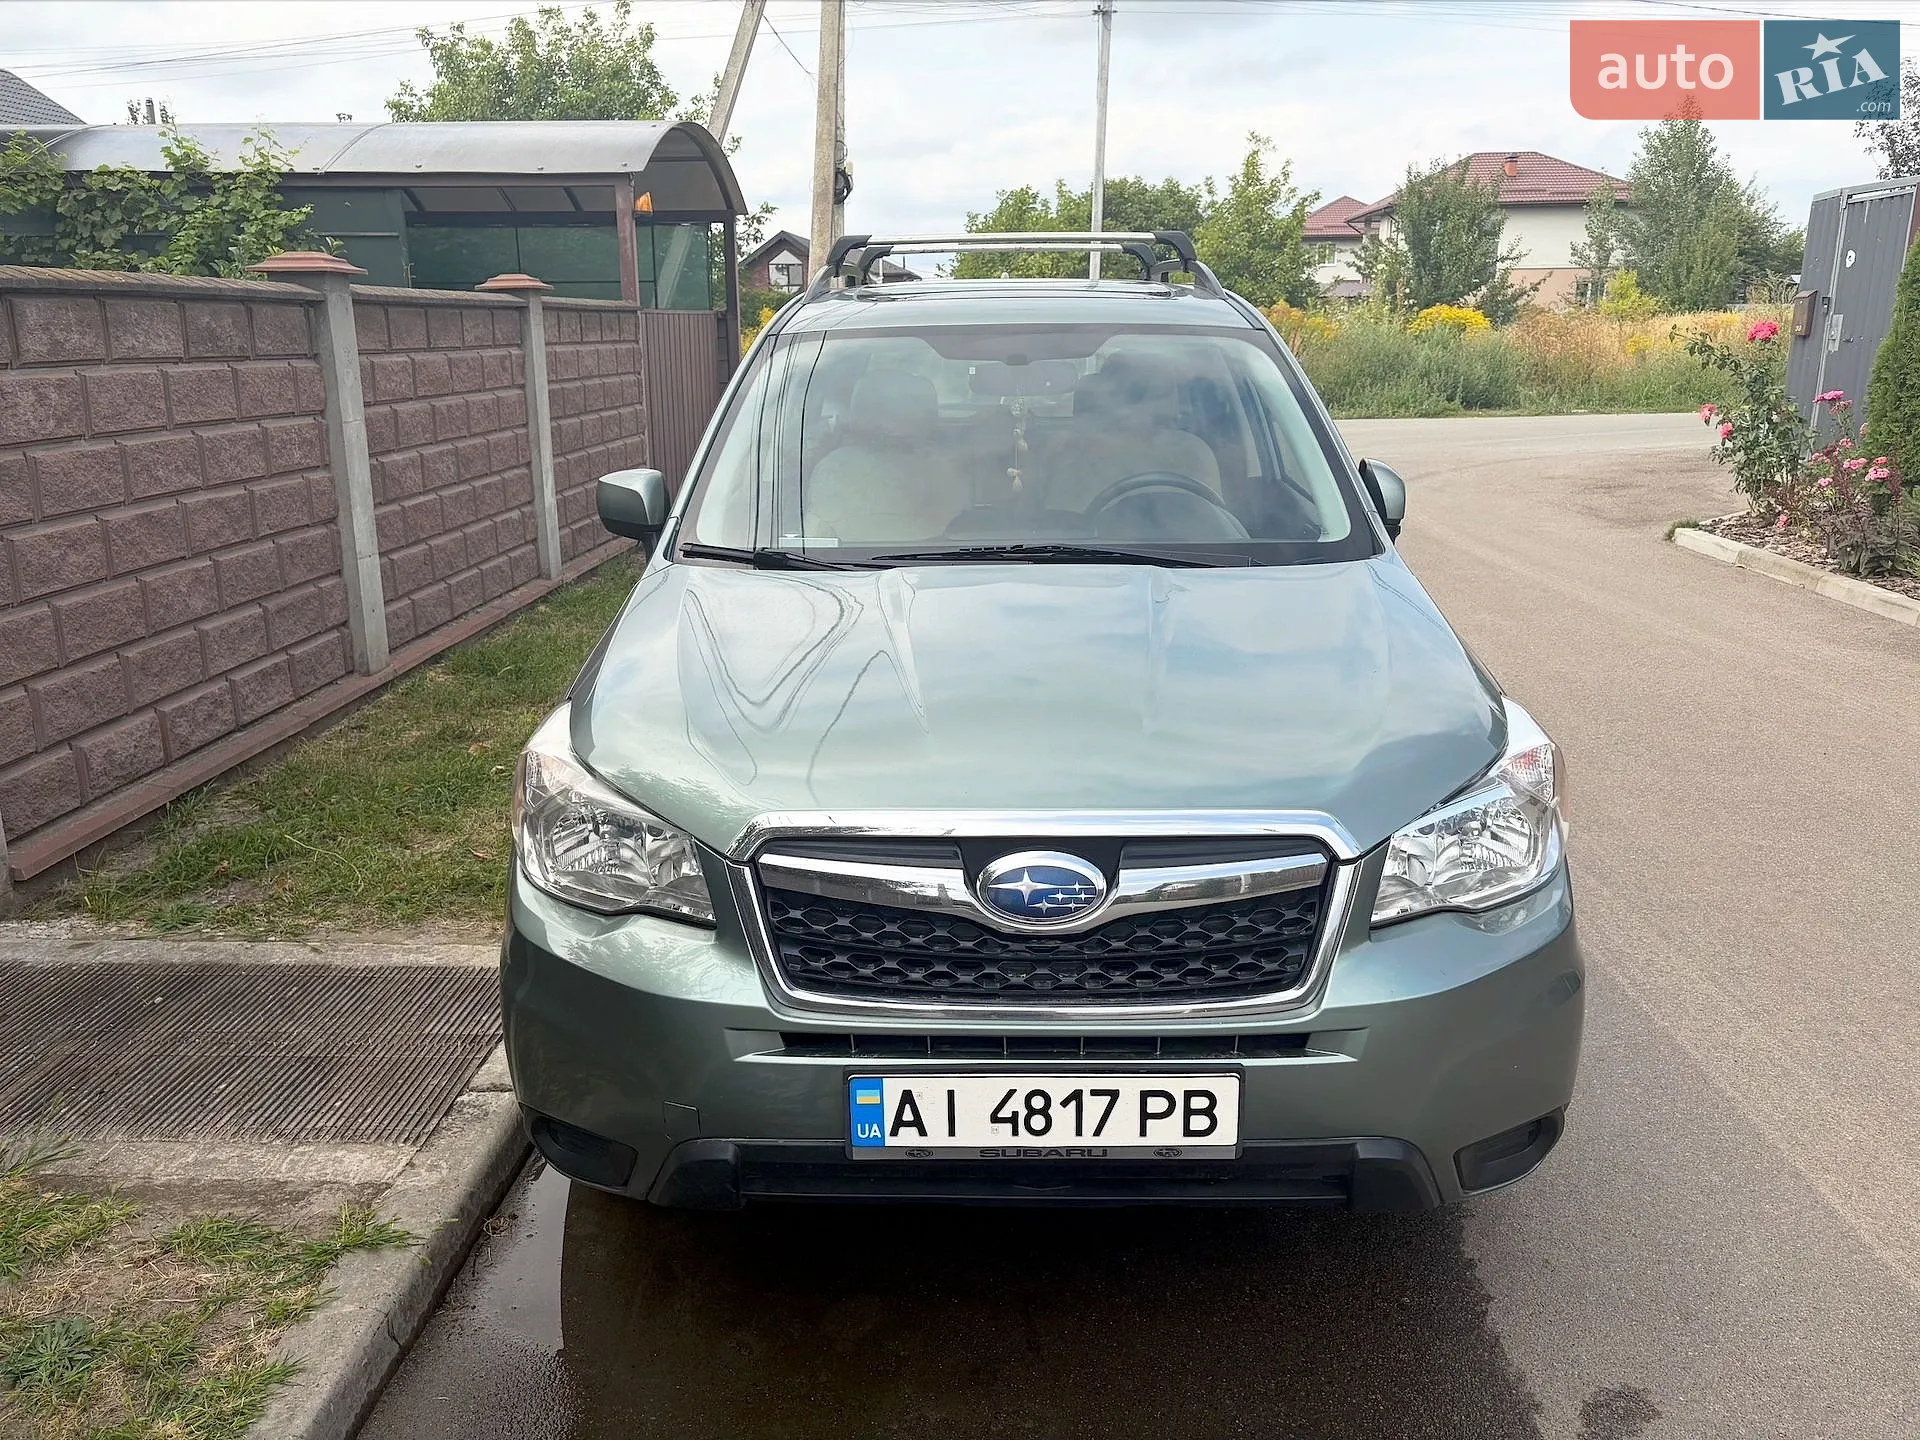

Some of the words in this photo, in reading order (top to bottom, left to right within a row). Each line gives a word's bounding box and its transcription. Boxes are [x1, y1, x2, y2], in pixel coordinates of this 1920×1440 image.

[990, 1089, 1120, 1137] 4817
[1139, 1089, 1218, 1137] PB
[857, 1123, 881, 1139] UA
[979, 1148, 1108, 1158] SUBARU
